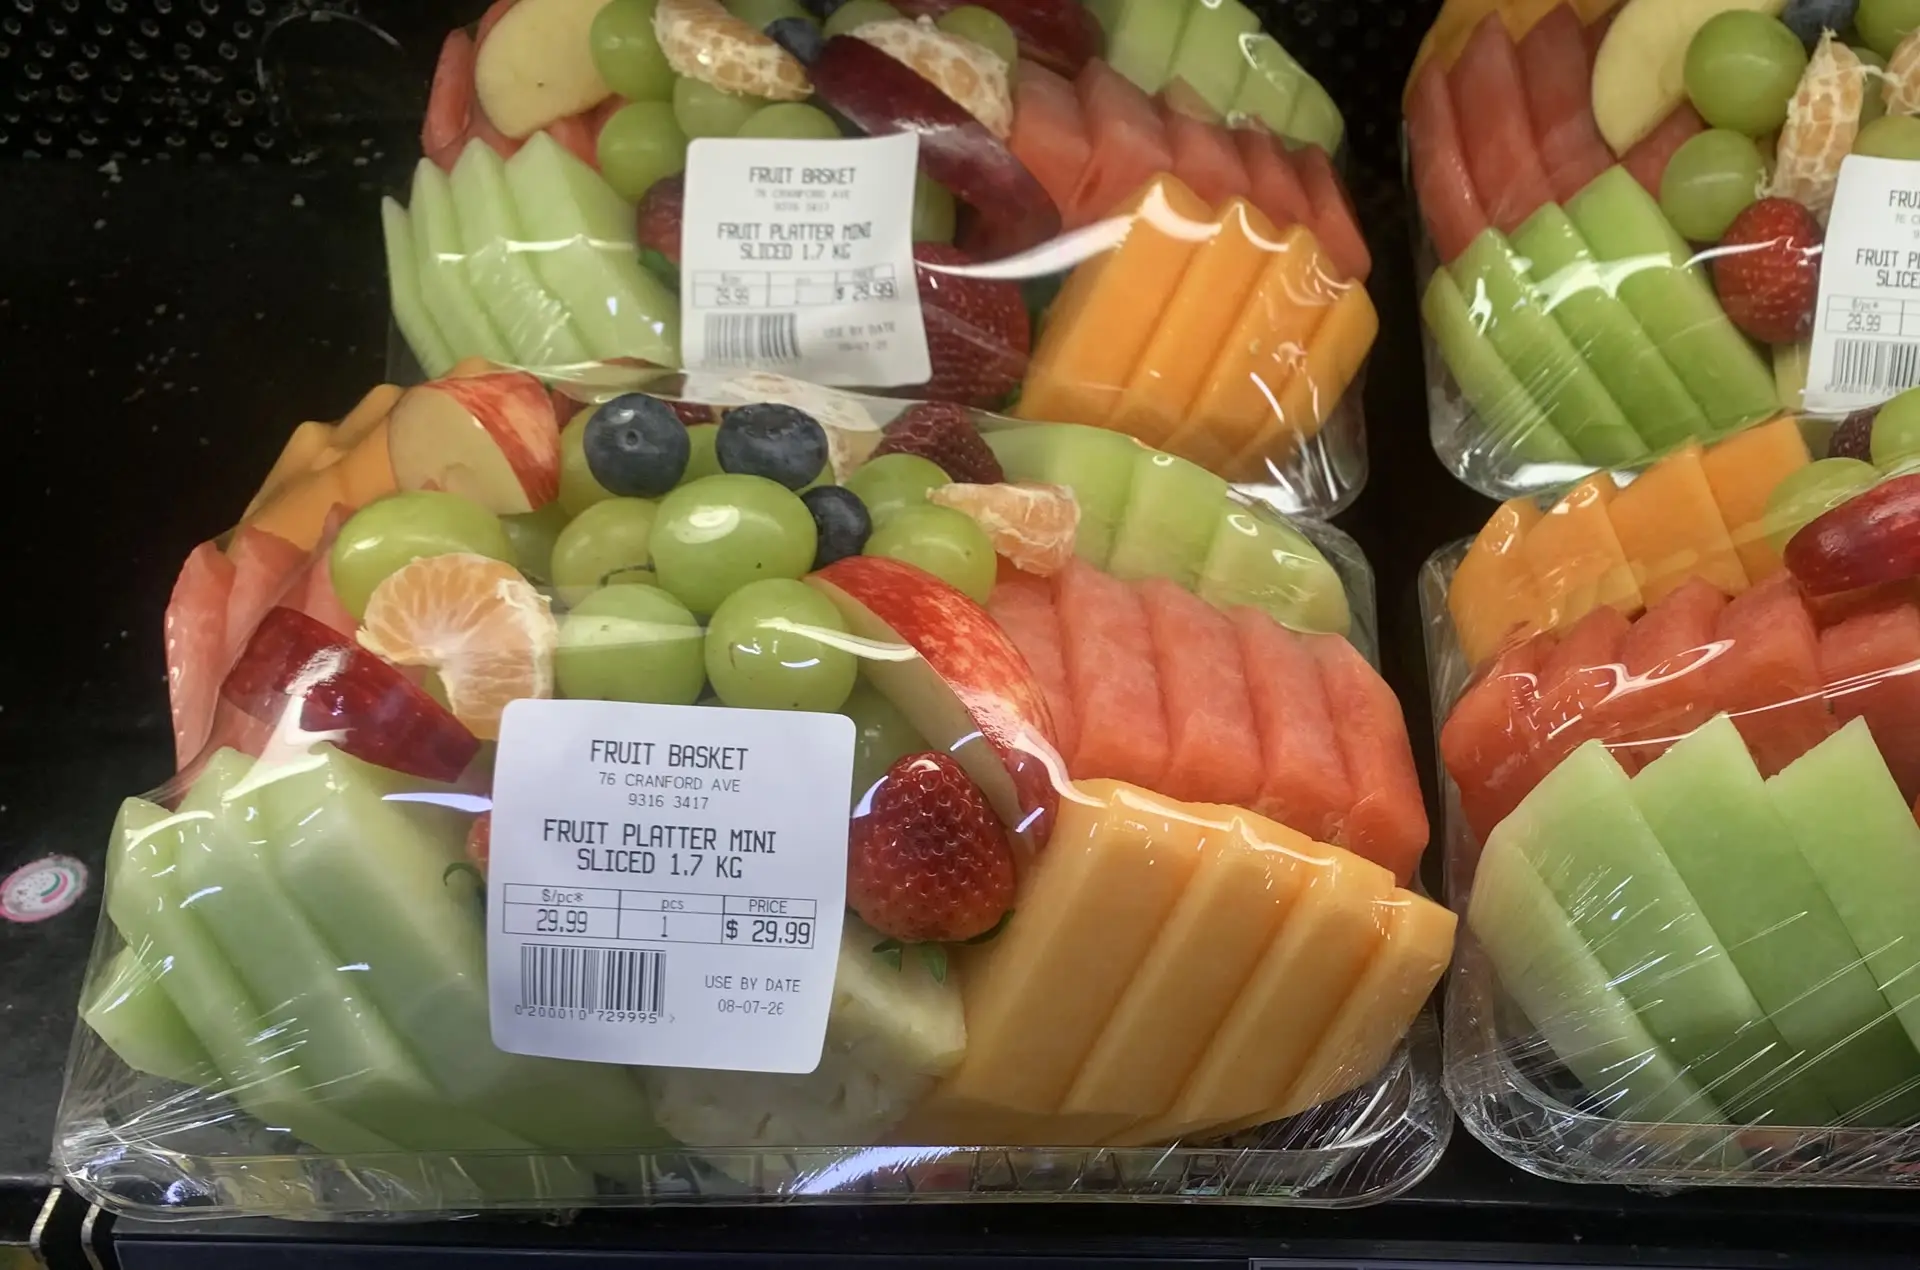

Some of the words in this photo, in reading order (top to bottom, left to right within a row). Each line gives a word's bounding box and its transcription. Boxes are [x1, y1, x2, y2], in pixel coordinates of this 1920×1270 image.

[749, 166, 794, 184] FRUIT
[801, 166, 857, 185] BASKET
[717, 222, 761, 241] FRUIT
[769, 223, 834, 241] PLATTER
[802, 243, 825, 261] 1.7
[1856, 248, 1899, 267] FRUIT
[1846, 313, 1882, 332] 29.99
[590, 739, 656, 767] FRUIT
[668, 744, 749, 771] BASKET
[599, 772, 617, 786] 76
[625, 773, 703, 791] CRANFORD
[711, 778, 742, 793] AVE
[628, 792, 665, 808] 9316
[673, 796, 709, 811] 3417
[543, 818, 610, 845] FRUIT
[622, 823, 717, 851] PLATTER
[729, 829, 777, 854] MINI
[577, 848, 656, 875] SLICED
[670, 854, 704, 877] 1.7
[716, 856, 743, 880] KG
[660, 899, 685, 912] pcs
[749, 900, 788, 915] PRICE
[536, 908, 589, 934] 29.99
[660, 914, 669, 938] 1
[725, 918, 740, 941] $
[751, 919, 812, 945] 29.99
[704, 975, 733, 990] USE
[740, 976, 759, 991] BY
[765, 978, 801, 993] DATE
[718, 998, 785, 1016] 08-07-26
